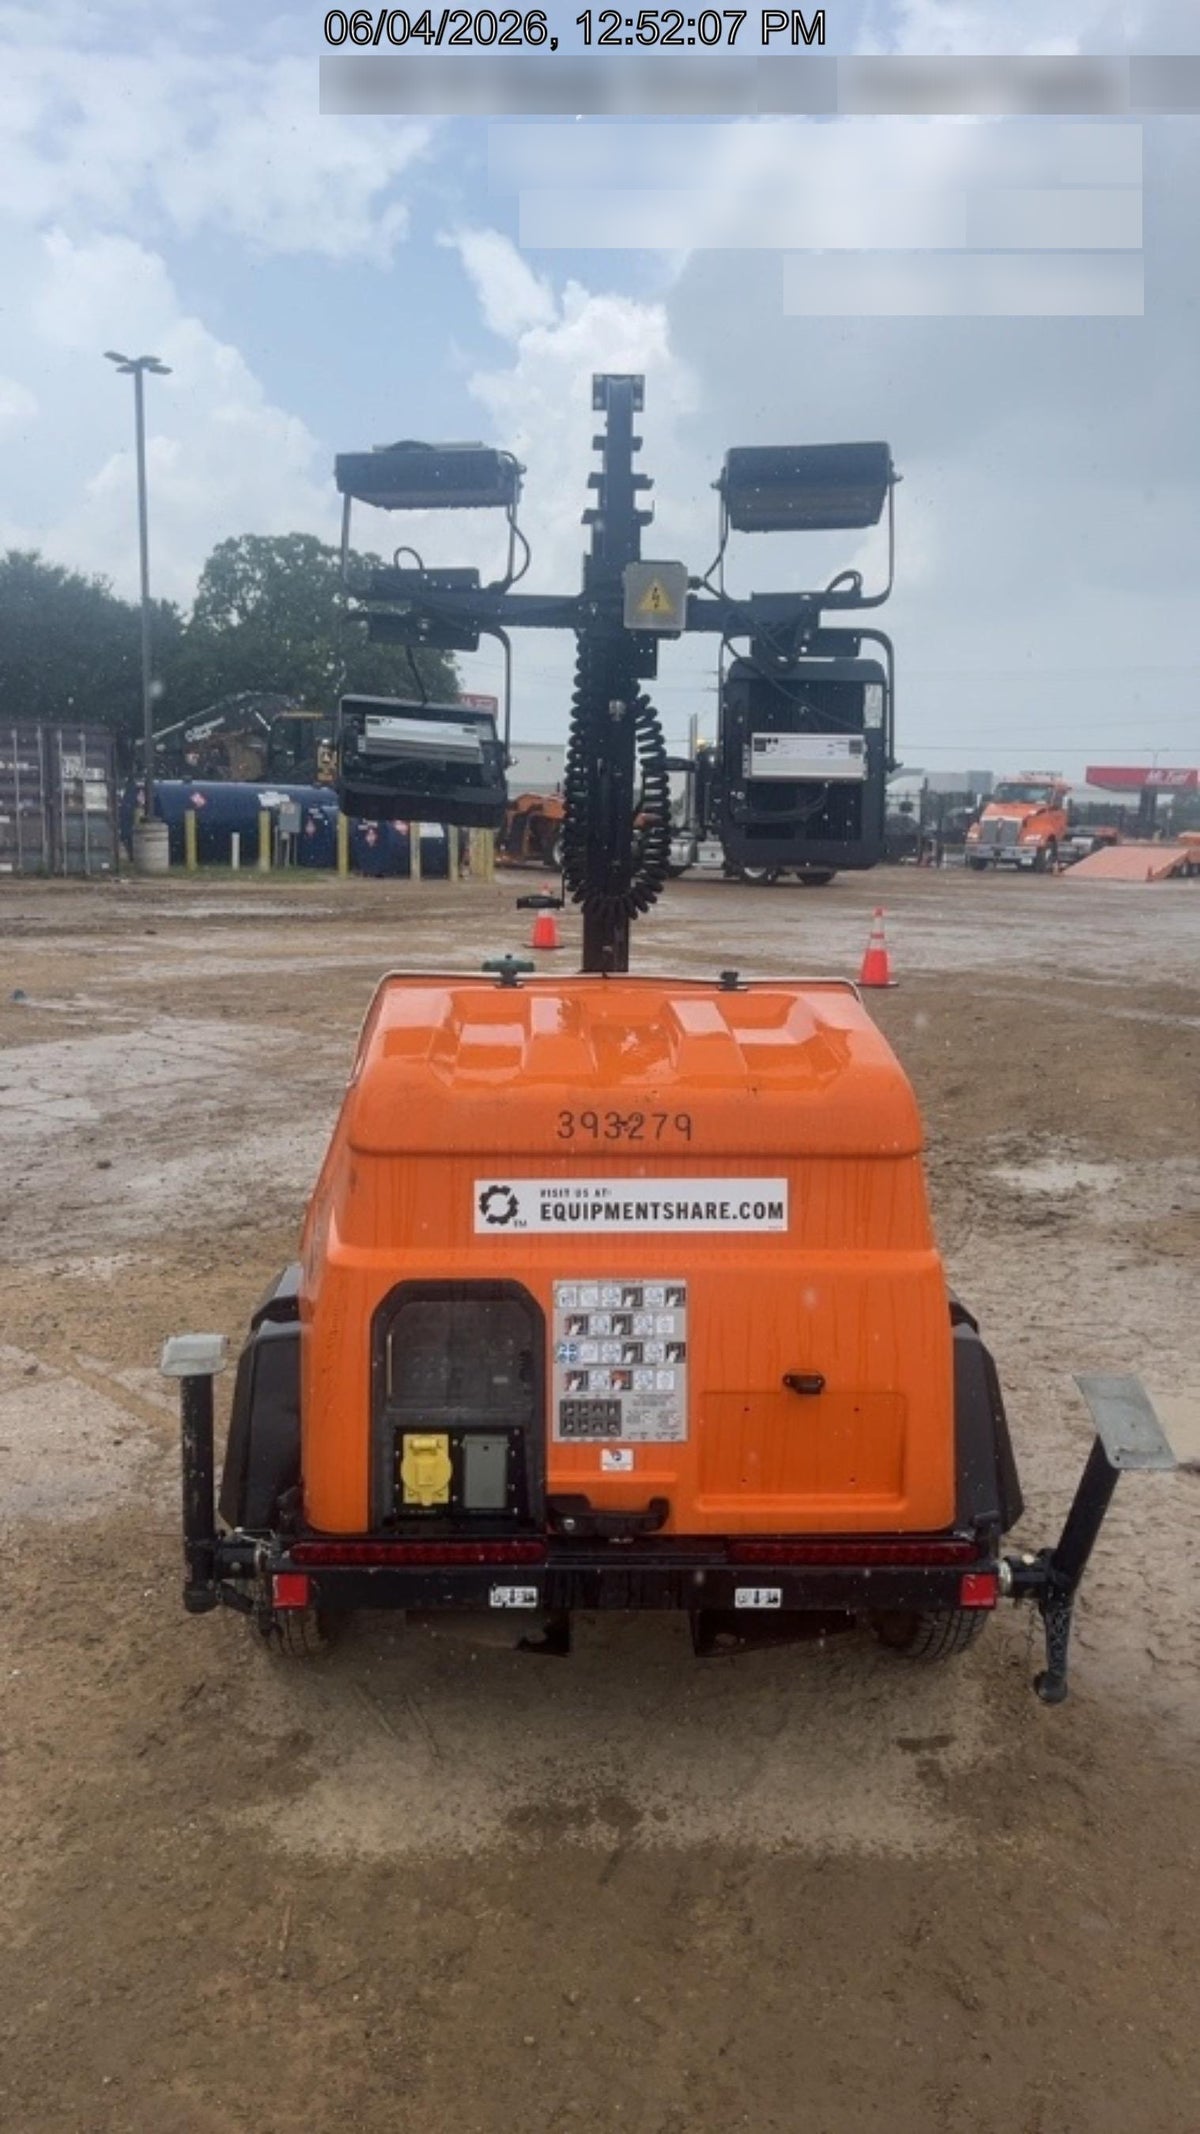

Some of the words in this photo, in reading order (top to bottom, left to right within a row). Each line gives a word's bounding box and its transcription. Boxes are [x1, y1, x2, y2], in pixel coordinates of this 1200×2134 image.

[556, 1111, 692, 1142] 393279
[540, 1188, 570, 1198] VISIT
[576, 1188, 589, 1198] US
[540, 1201, 784, 1222] EQUIPMENTSHARE.COM
